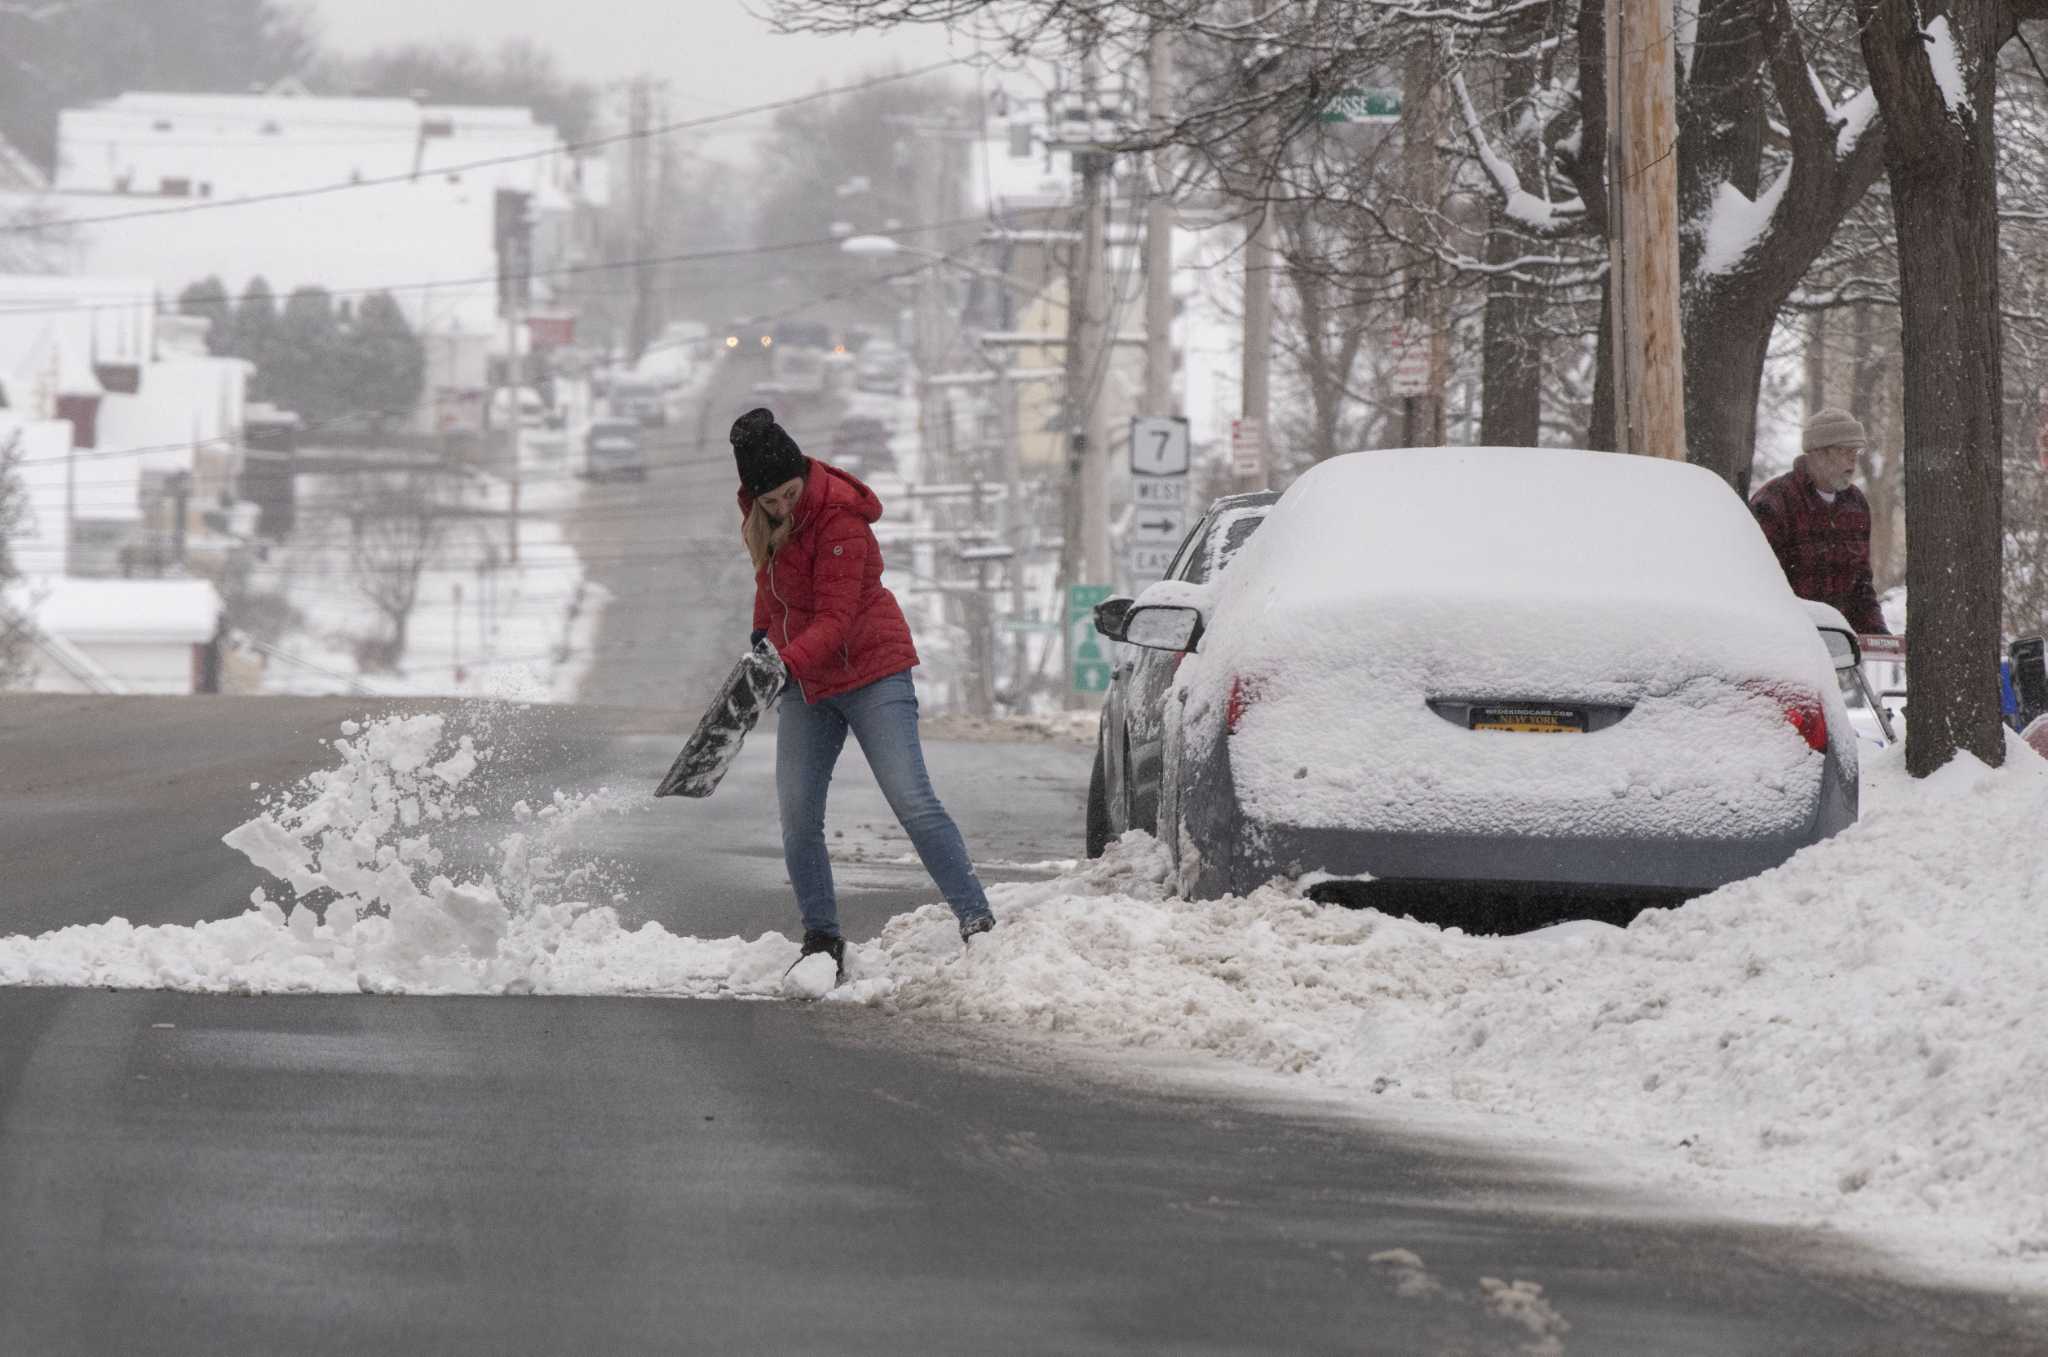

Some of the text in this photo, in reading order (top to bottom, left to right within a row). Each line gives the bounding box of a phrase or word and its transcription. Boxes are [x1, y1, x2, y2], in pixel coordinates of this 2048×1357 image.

[1149, 430, 1170, 461] 7
[1139, 483, 1181, 499] WEST
[1136, 553, 1170, 570] EAS
[1501, 715, 1559, 725] NEW YORK
